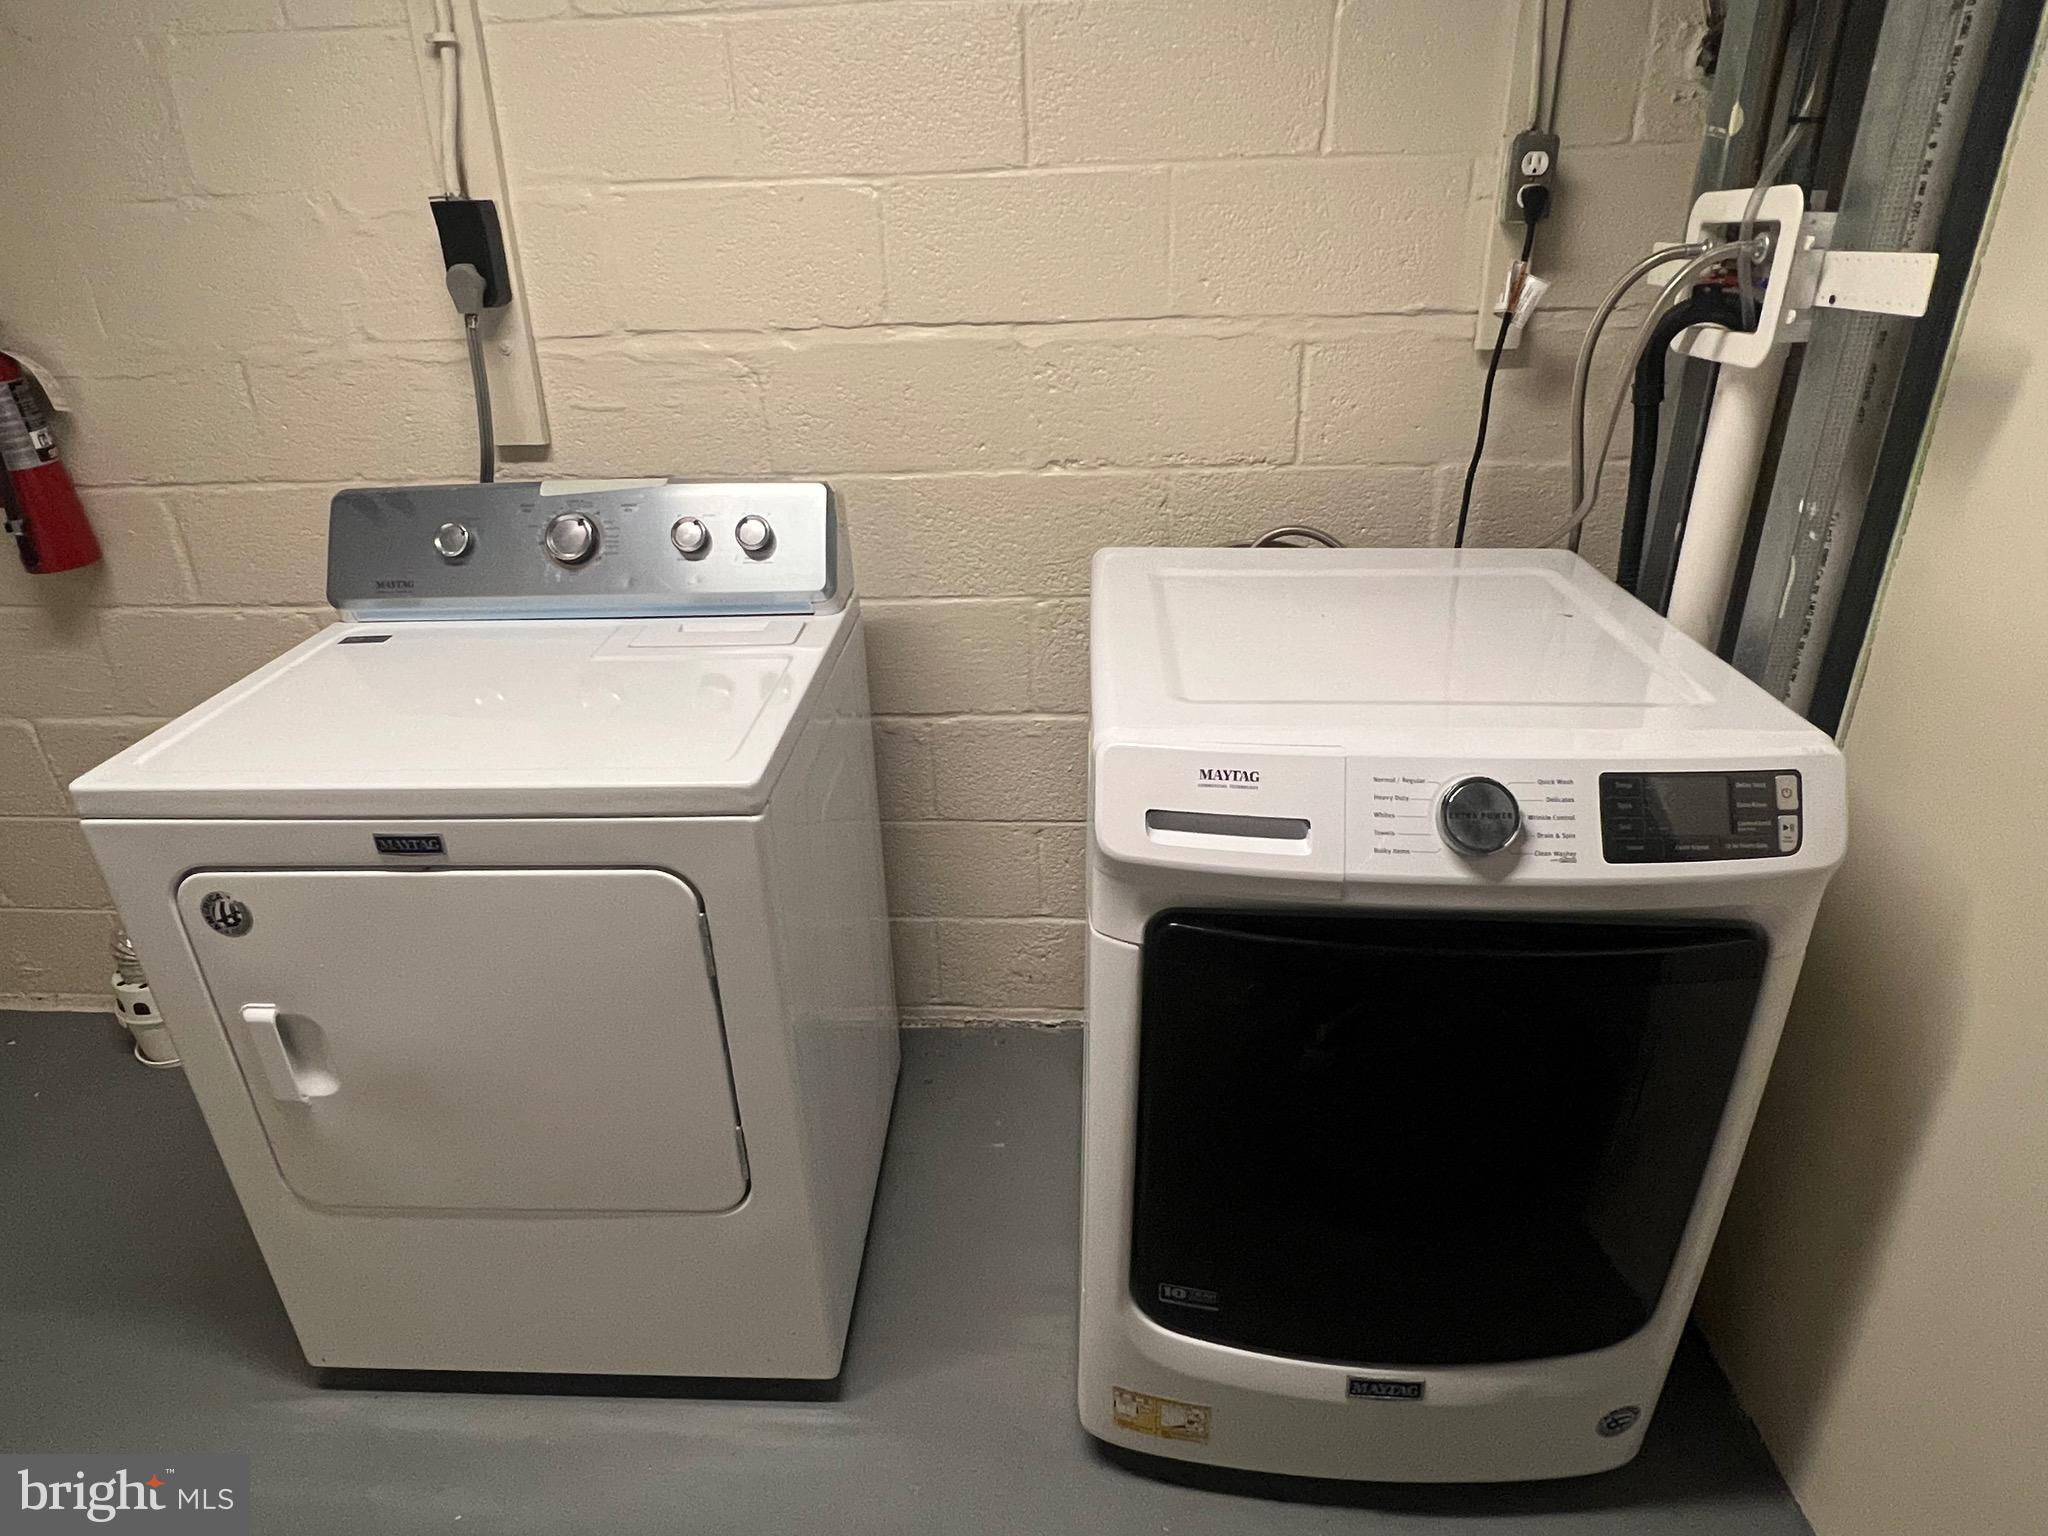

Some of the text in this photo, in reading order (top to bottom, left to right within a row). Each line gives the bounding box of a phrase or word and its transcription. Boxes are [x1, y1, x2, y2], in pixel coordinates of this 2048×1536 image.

[1199, 768, 1260, 783] MAYTAG
[1372, 776, 1396, 784] Normal
[1401, 776, 1426, 785] Regular
[1373, 794, 1409, 802] Heavy Duty
[1561, 832, 1576, 840] Spin
[379, 839, 440, 850] MAYTAG
[1534, 849, 1552, 857] Clean
[1351, 1382, 1419, 1396] MAYTAG
